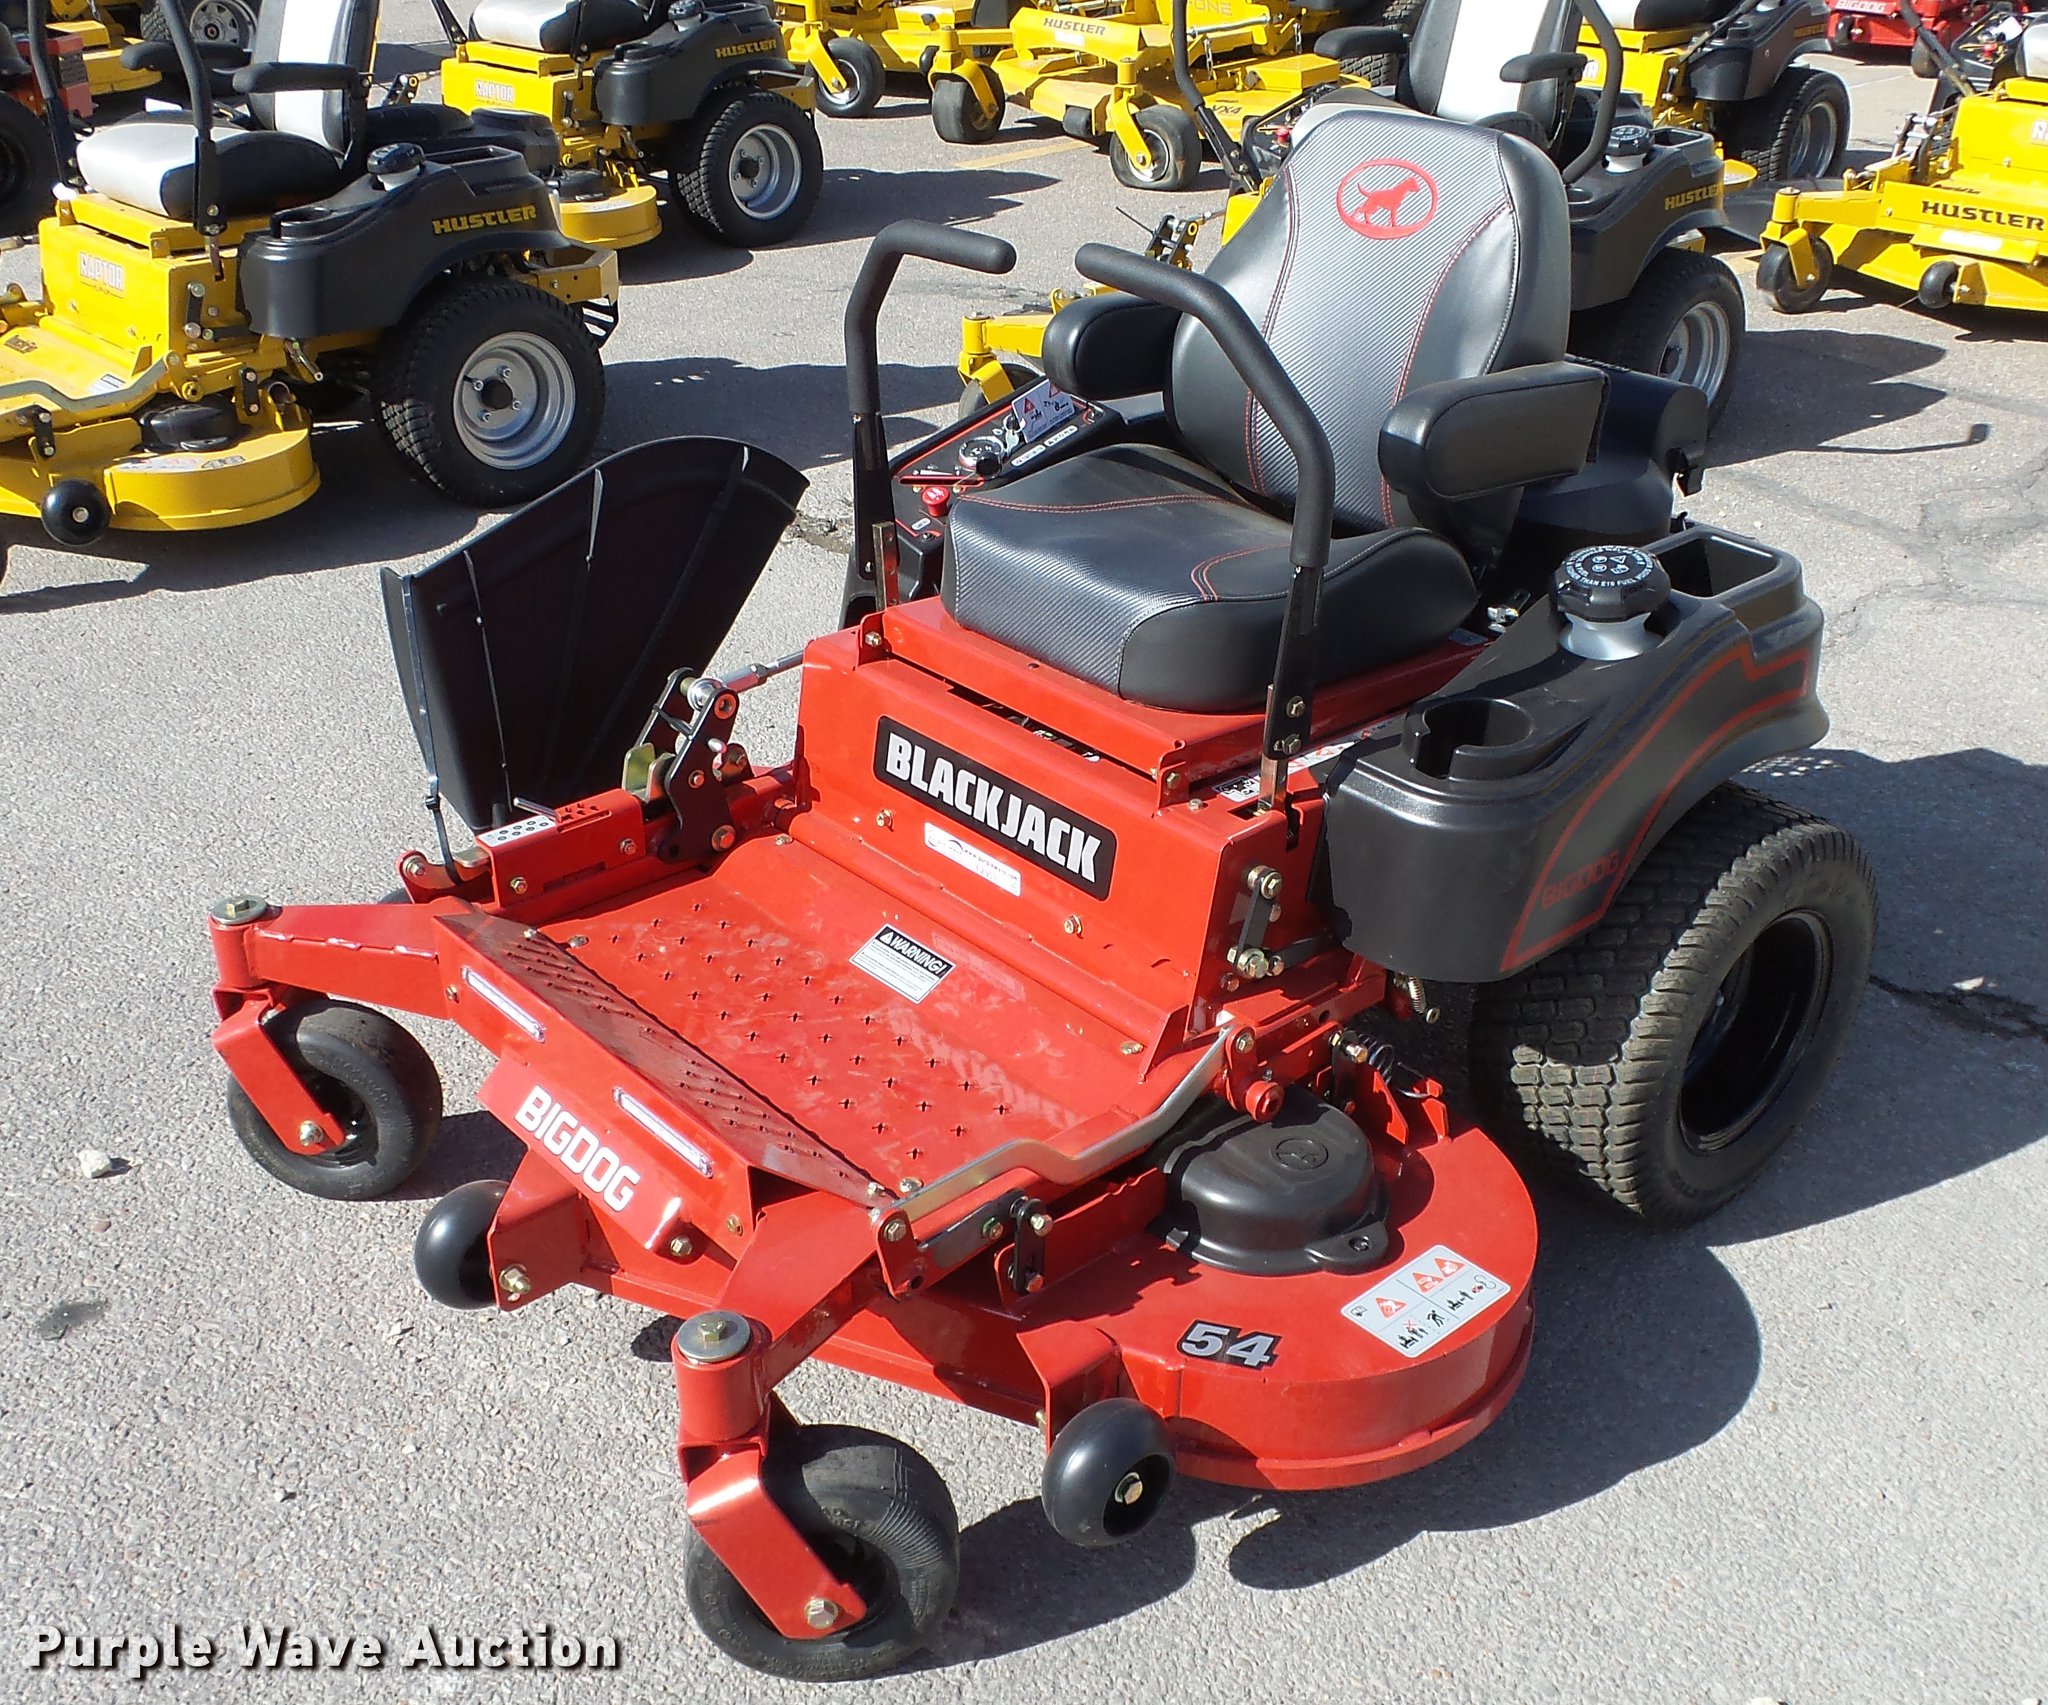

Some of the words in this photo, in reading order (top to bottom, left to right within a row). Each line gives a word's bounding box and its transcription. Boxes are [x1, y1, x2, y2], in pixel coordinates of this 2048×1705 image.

[1043, 18, 1106, 35] HUSTLER
[714, 39, 777, 58] HUSTLER
[431, 204, 537, 235] HUSTLER
[1921, 200, 2045, 231] HUSTLER
[79, 250, 124, 291] RAPTOR
[886, 732, 1101, 883] BLACKJACK
[889, 935, 948, 975] WARNING!
[514, 1084, 641, 1212] BIGDOG
[1181, 1322, 1271, 1367] 54
